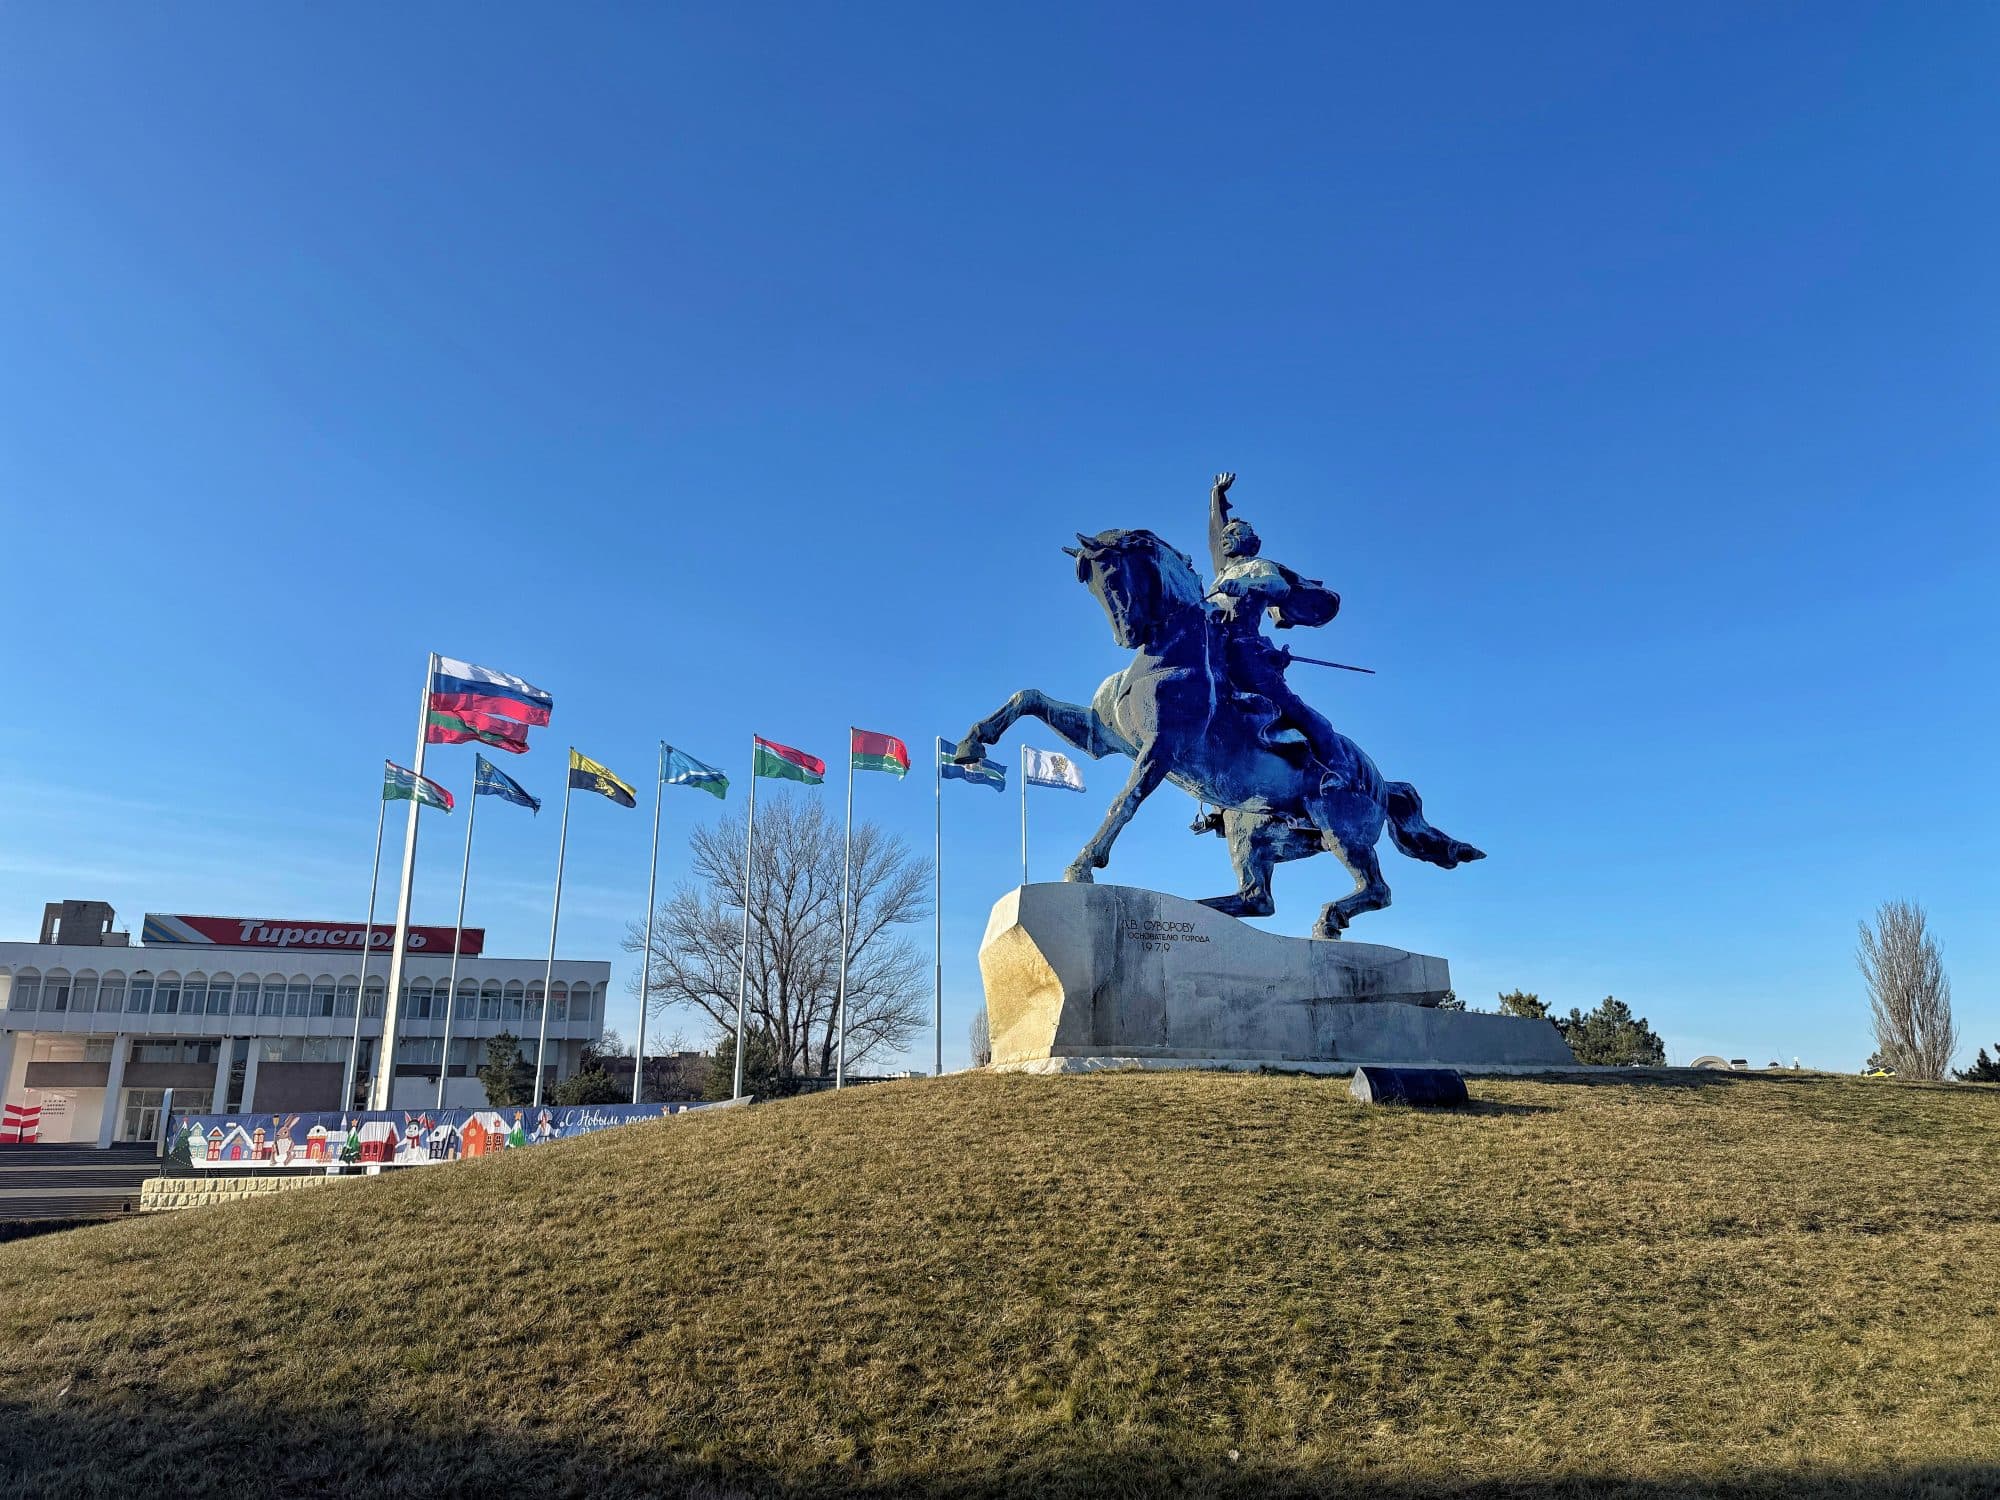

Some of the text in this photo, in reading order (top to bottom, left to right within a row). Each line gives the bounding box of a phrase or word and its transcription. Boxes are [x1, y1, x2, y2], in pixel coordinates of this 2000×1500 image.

[1143, 920, 1195, 933] СУВОРОВУ
[1127, 932, 1211, 943] ОСНОВАТЕЛЮ ГОРОДА
[1141, 942, 1171, 952] 1979
[565, 1109, 575, 1127] С
[576, 1109, 620, 1127] Новым
